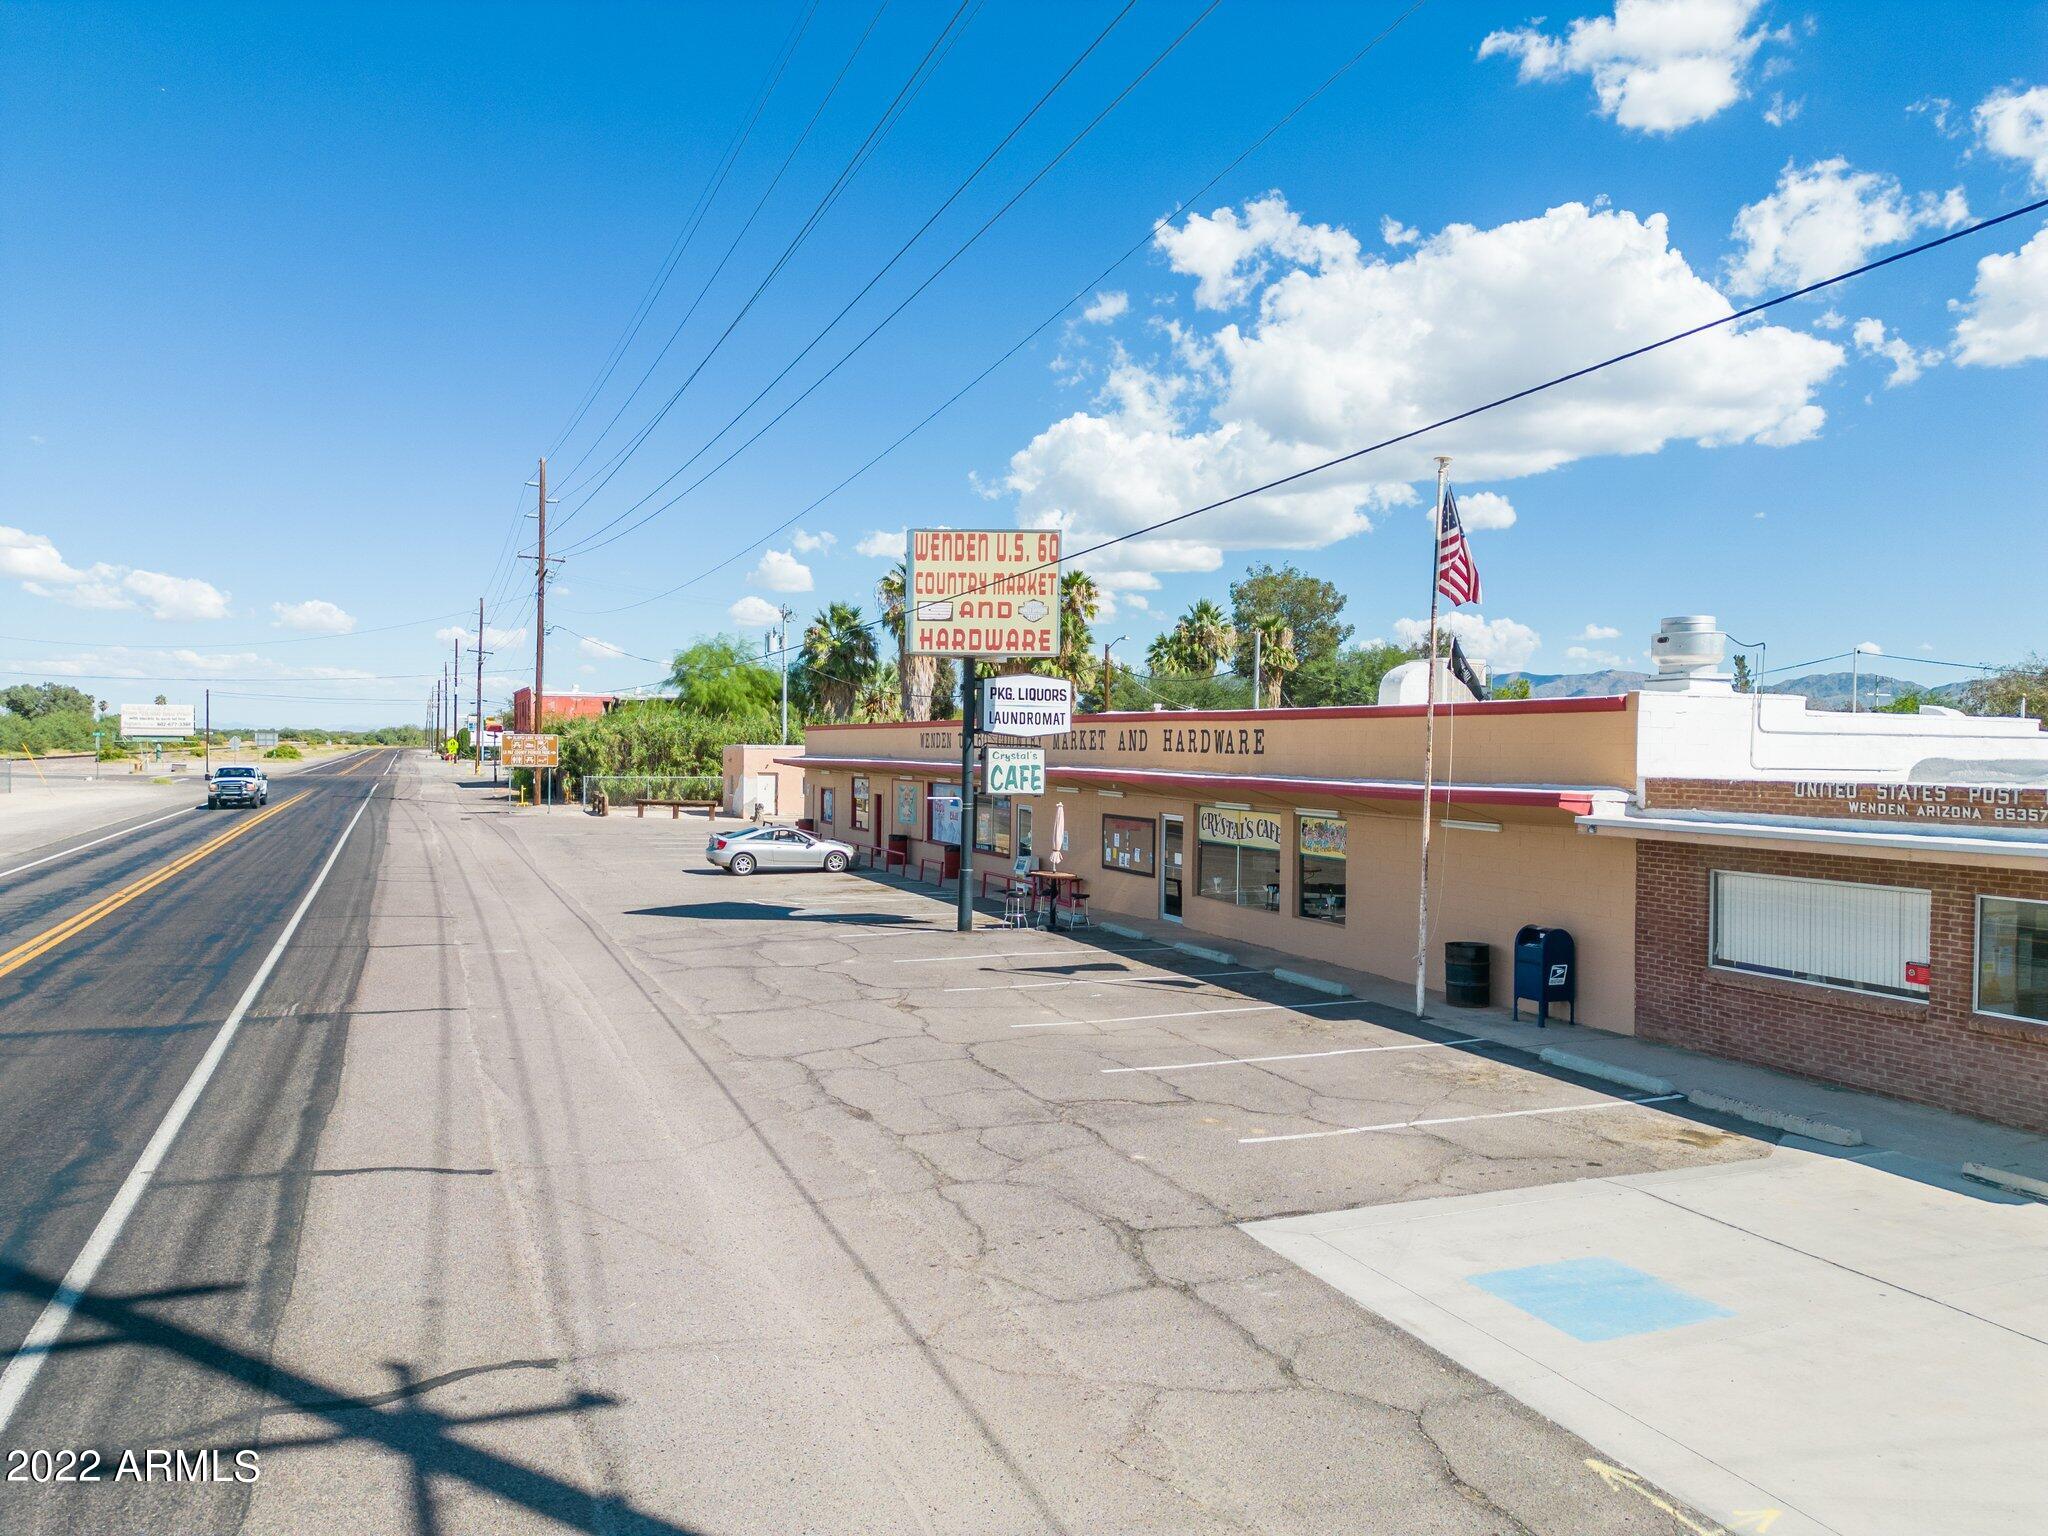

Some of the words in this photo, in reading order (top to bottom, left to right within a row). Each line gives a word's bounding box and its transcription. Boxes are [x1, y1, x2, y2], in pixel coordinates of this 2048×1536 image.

[915, 533, 989, 562] WENDEN
[996, 533, 1030, 562] U.S.
[1037, 533, 1060, 563] 60
[915, 571, 987, 596] COUNTRY
[993, 572, 1057, 596] MARKET
[959, 600, 1013, 619] AND
[919, 628, 1052, 651] HARDWARE
[989, 687, 1015, 701] PKG.
[1018, 687, 1068, 702] LIQUORS
[988, 711, 1066, 726] LAUNDROMAT
[920, 732, 952, 749] WENDEN
[1052, 729, 1106, 751] MARKET
[1118, 729, 1148, 752] AND
[1163, 728, 1265, 755] HARDWARE
[992, 751, 1038, 763] Crystal's
[991, 764, 1042, 792] CAFE
[1794, 781, 1858, 799] UNITED
[1876, 783, 1948, 802] STATES
[1968, 786, 2022, 805] POST
[1917, 805, 1982, 819] ARIZONA
[1994, 807, 2048, 823] 85357
[1201, 812, 1254, 840] CRYSTAL'S
